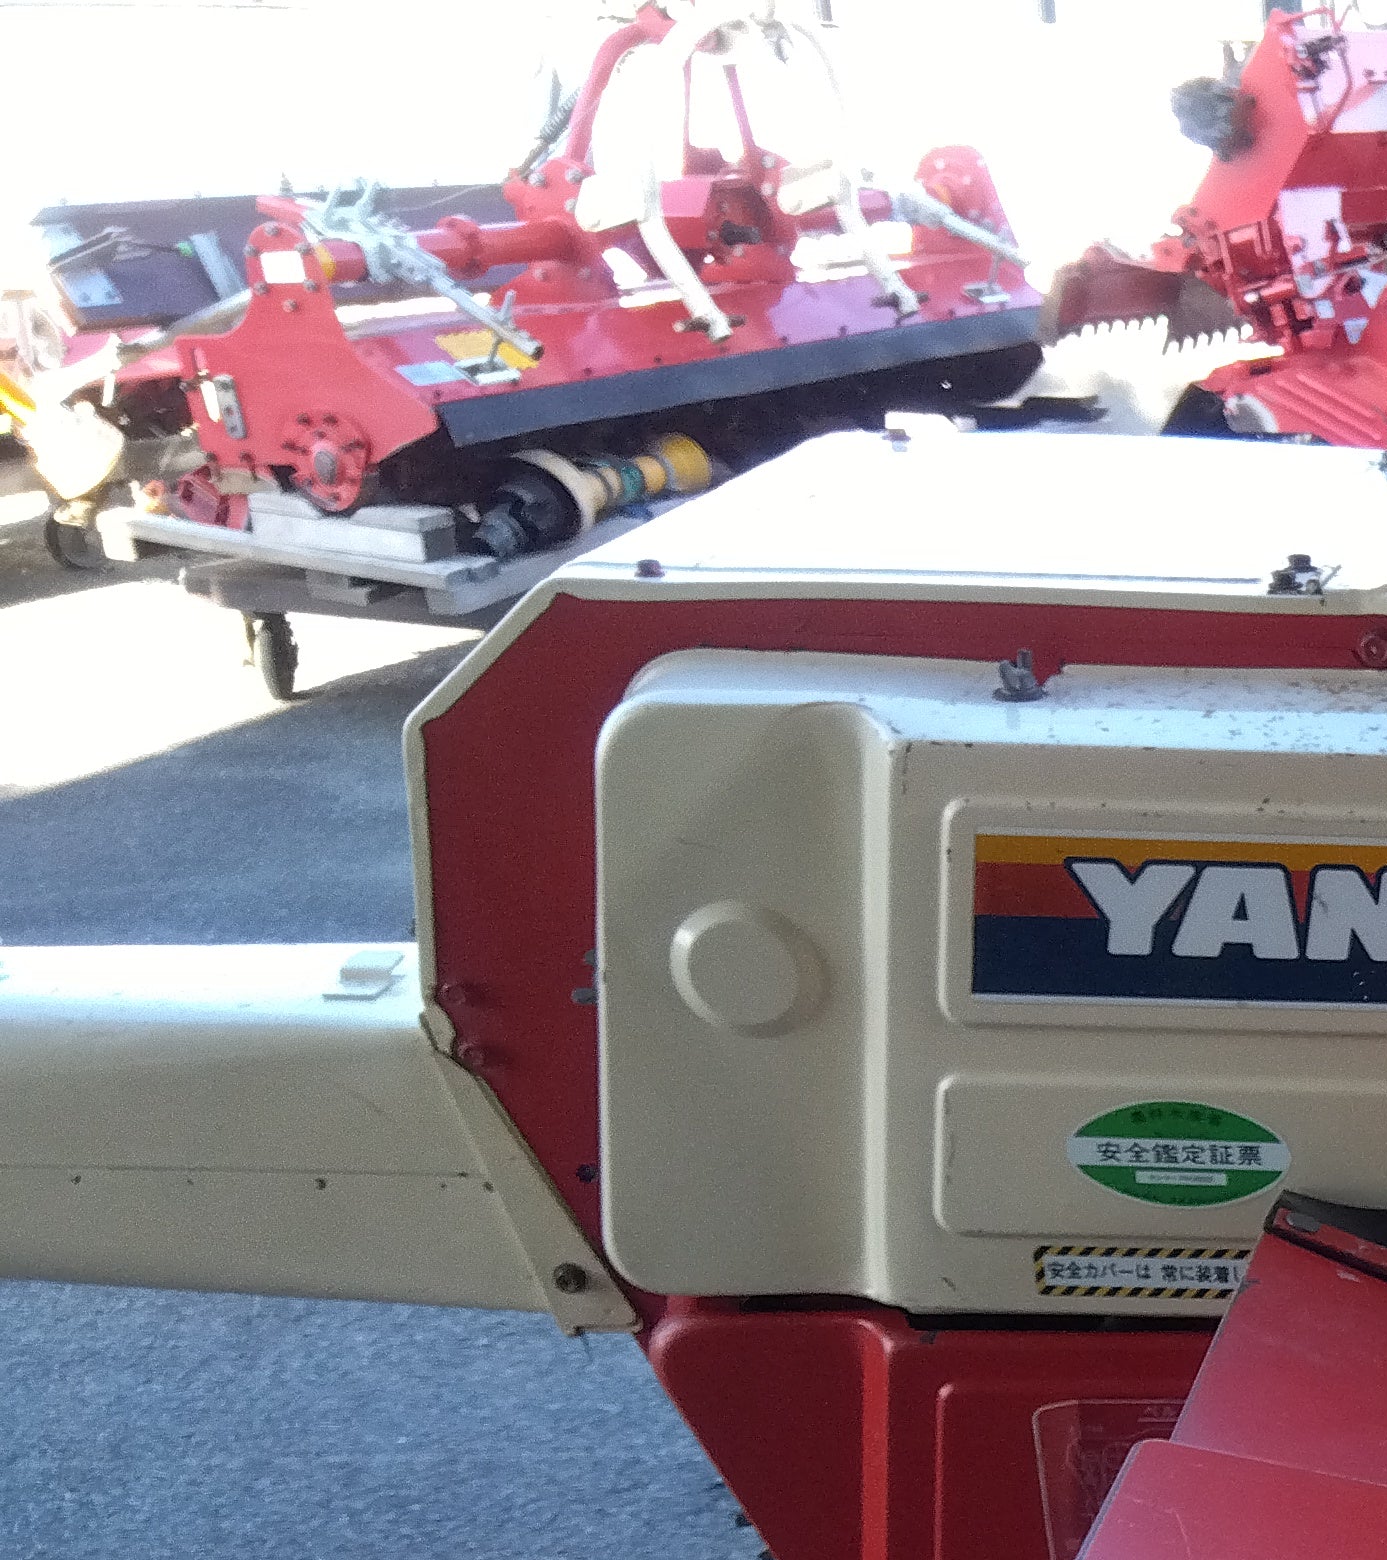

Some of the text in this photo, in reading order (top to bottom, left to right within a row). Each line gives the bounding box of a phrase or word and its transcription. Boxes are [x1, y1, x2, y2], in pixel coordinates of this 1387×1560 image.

[1097, 1141, 1263, 1167] 安全鑑定証票
[1047, 1261, 1152, 1281] 安全カバーは
